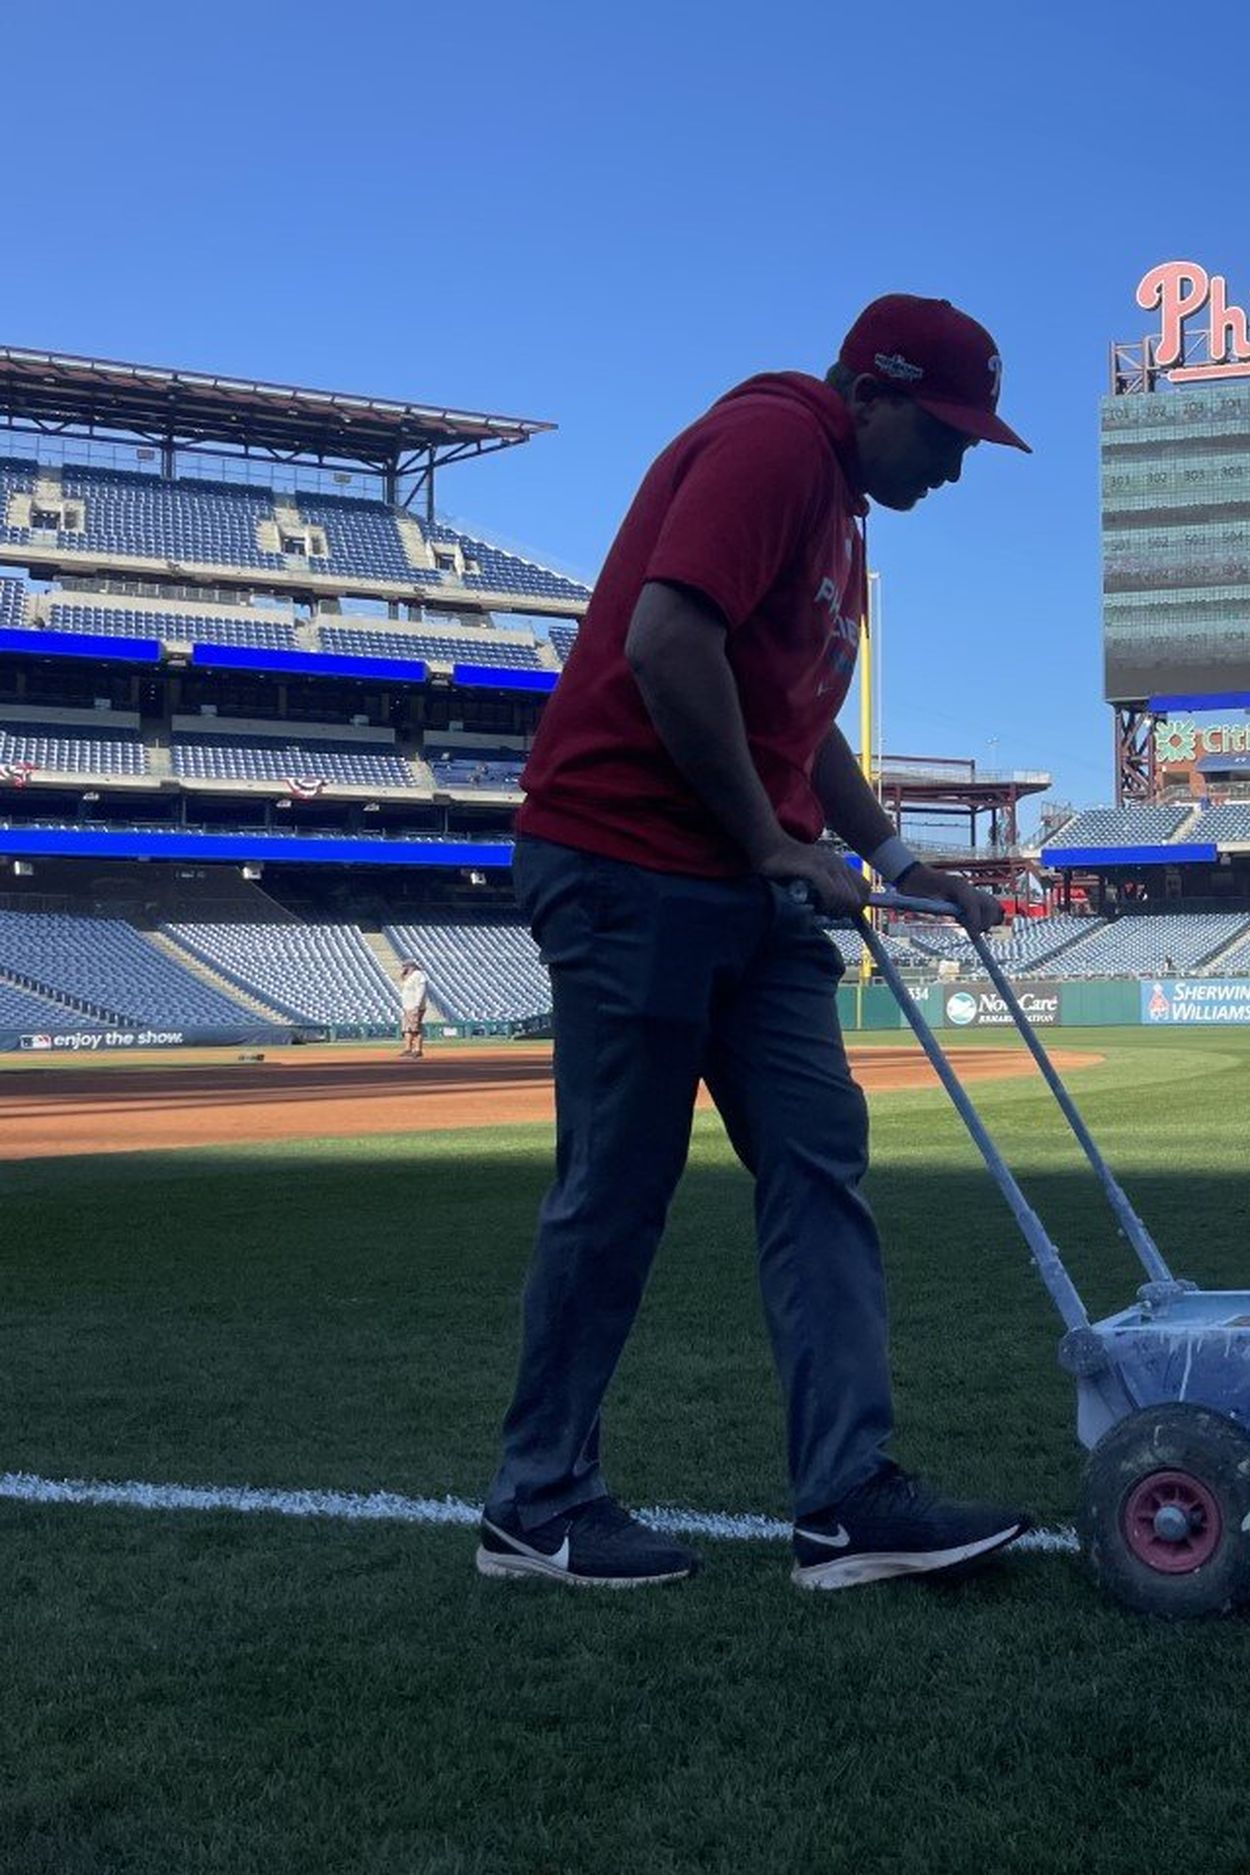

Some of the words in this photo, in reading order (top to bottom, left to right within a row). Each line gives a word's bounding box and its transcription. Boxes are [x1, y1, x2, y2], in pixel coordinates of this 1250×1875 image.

[977, 994, 1059, 1013] NovCare
[53, 1031, 101, 1050] enjoy
[105, 1031, 134, 1046] the
[137, 1030, 183, 1045] show.
